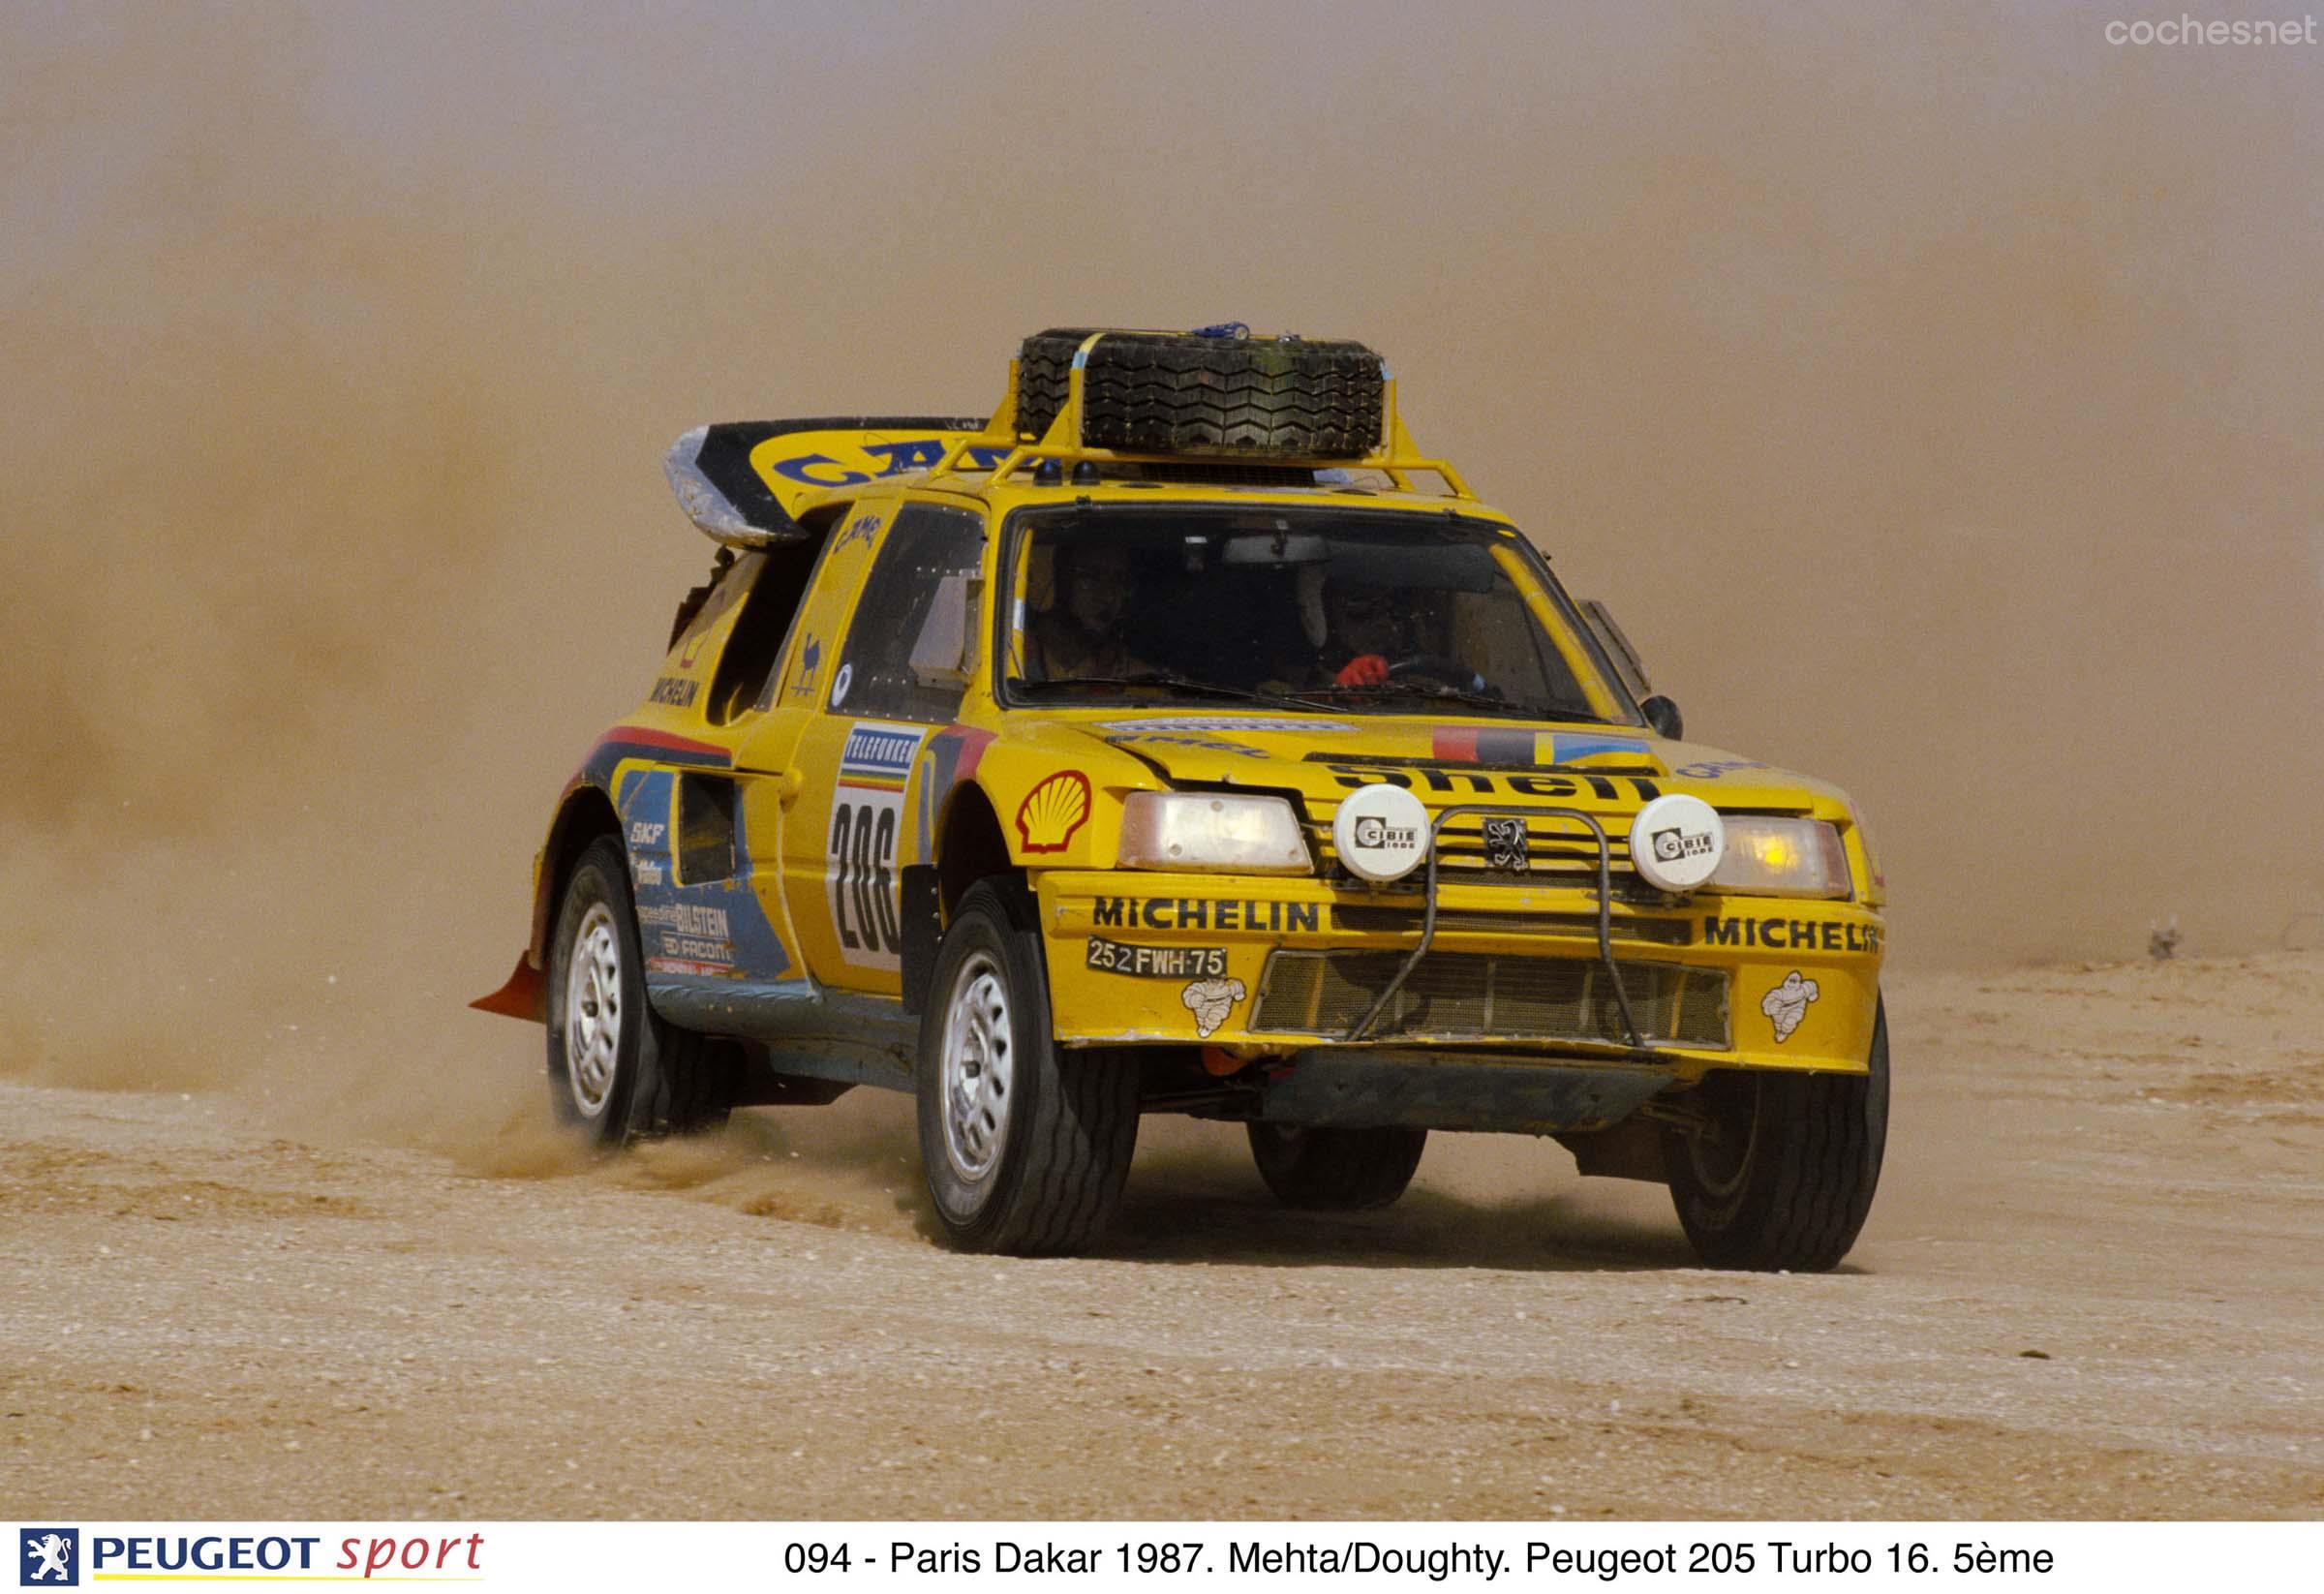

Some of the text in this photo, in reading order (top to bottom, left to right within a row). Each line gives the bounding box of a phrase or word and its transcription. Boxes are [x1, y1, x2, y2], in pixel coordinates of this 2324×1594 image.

[650, 677, 699, 708] MICHELIN
[846, 735, 921, 763] TELEFUNKEN
[1326, 765, 1661, 804] Shell
[630, 822, 664, 844] SKF
[831, 803, 902, 955] 206
[676, 902, 728, 939] BILSTEIN
[1092, 896, 1319, 932] MICHELIN
[1705, 915, 1879, 953] MICHELIN
